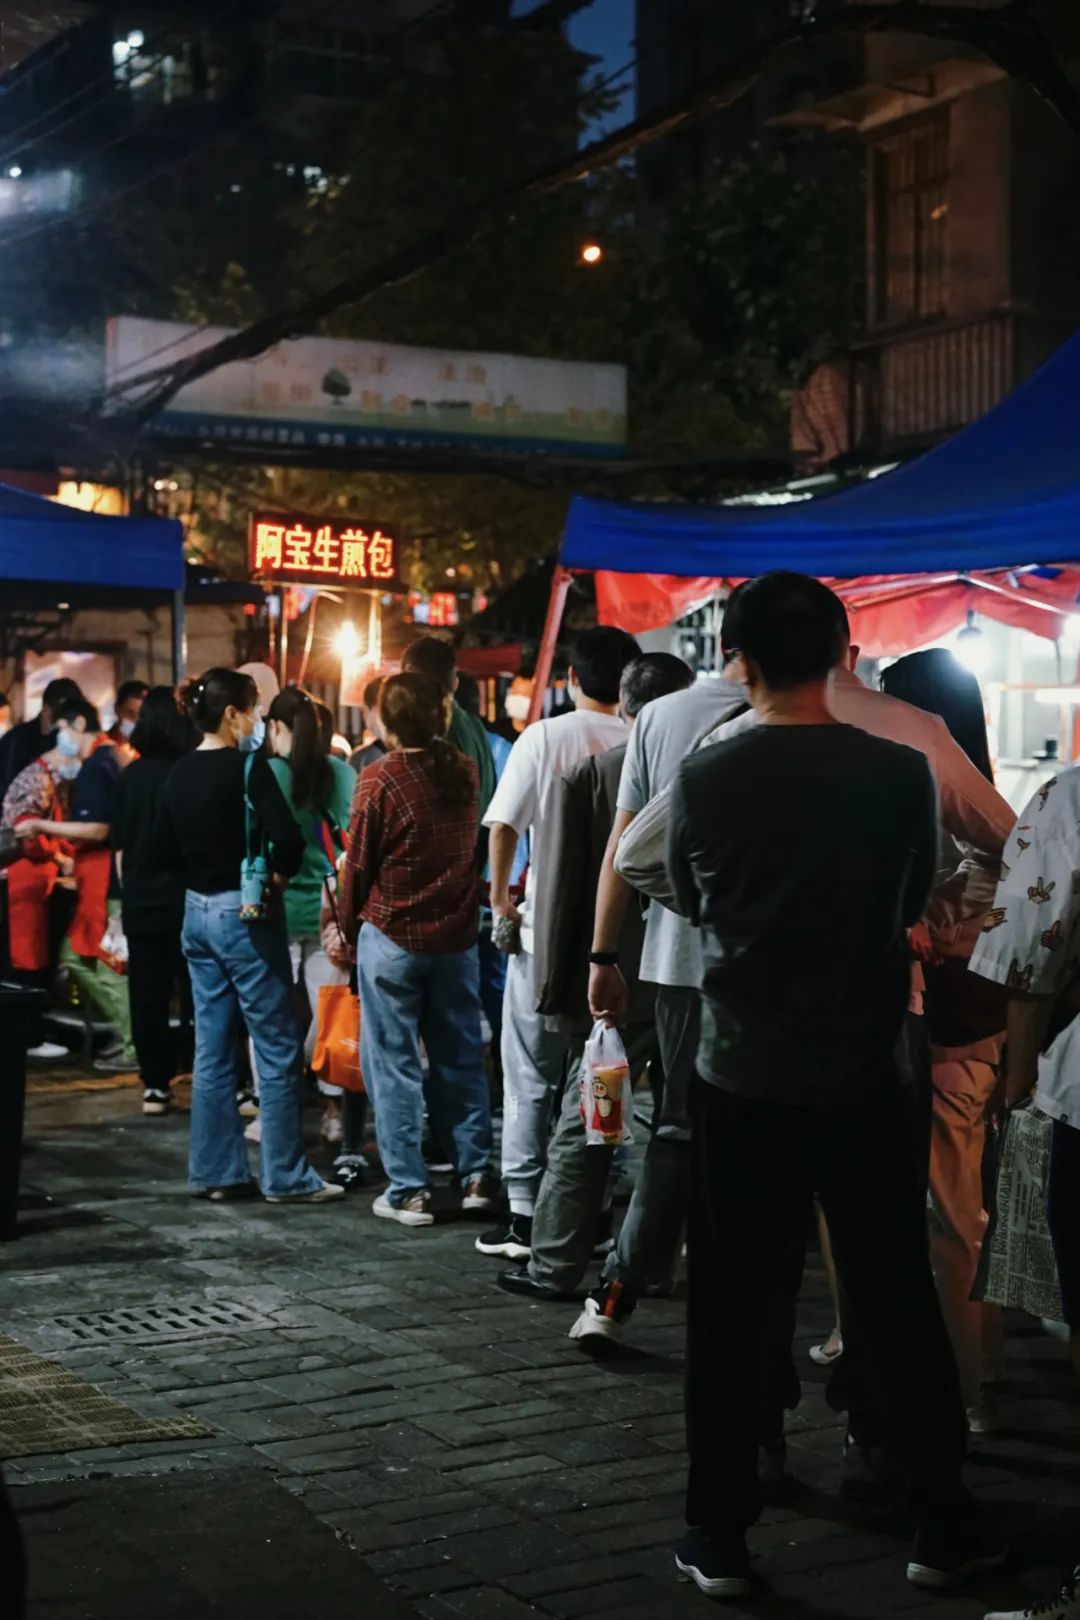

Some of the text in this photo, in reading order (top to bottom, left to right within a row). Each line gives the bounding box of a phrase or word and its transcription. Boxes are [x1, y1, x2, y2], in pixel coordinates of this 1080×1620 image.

[255, 524, 395, 577] 阿宝生煎包
